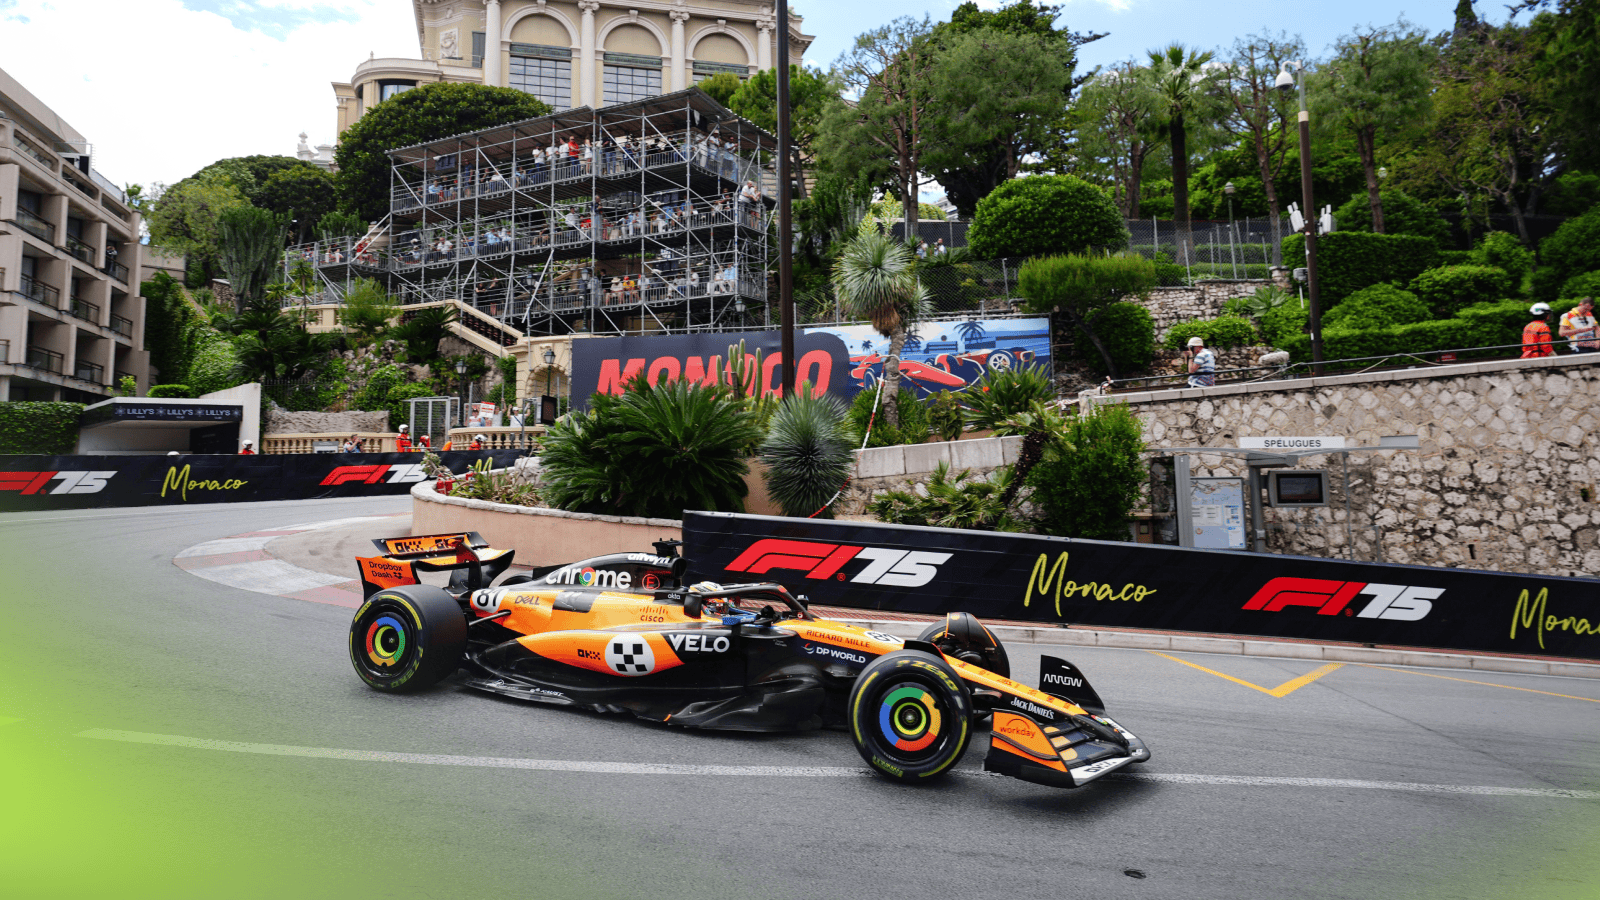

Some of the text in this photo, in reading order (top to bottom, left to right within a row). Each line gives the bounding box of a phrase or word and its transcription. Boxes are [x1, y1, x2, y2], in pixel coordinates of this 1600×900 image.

[1264, 438, 1322, 448] SPÉLUGUES
[49, 471, 118, 494] 75
[161, 464, 248, 501] Monaco
[369, 561, 403, 572] Dropbox
[724, 538, 954, 587] F1 75
[371, 570, 392, 579] Dash
[1024, 551, 1157, 617] Monaco
[514, 595, 540, 606] DELL
[1241, 577, 1446, 621] F1 75
[1510, 587, 1600, 649] Mona
[668, 634, 730, 653] VELO
[806, 630, 871, 648] RICHARD MILLE
[815, 647, 866, 664] DP WORLD
[1043, 674, 1082, 688] ARROW
[1011, 697, 1028, 711] JACK
[1027, 703, 1055, 720] DANIEL'S
[1000, 727, 1036, 739] workday
